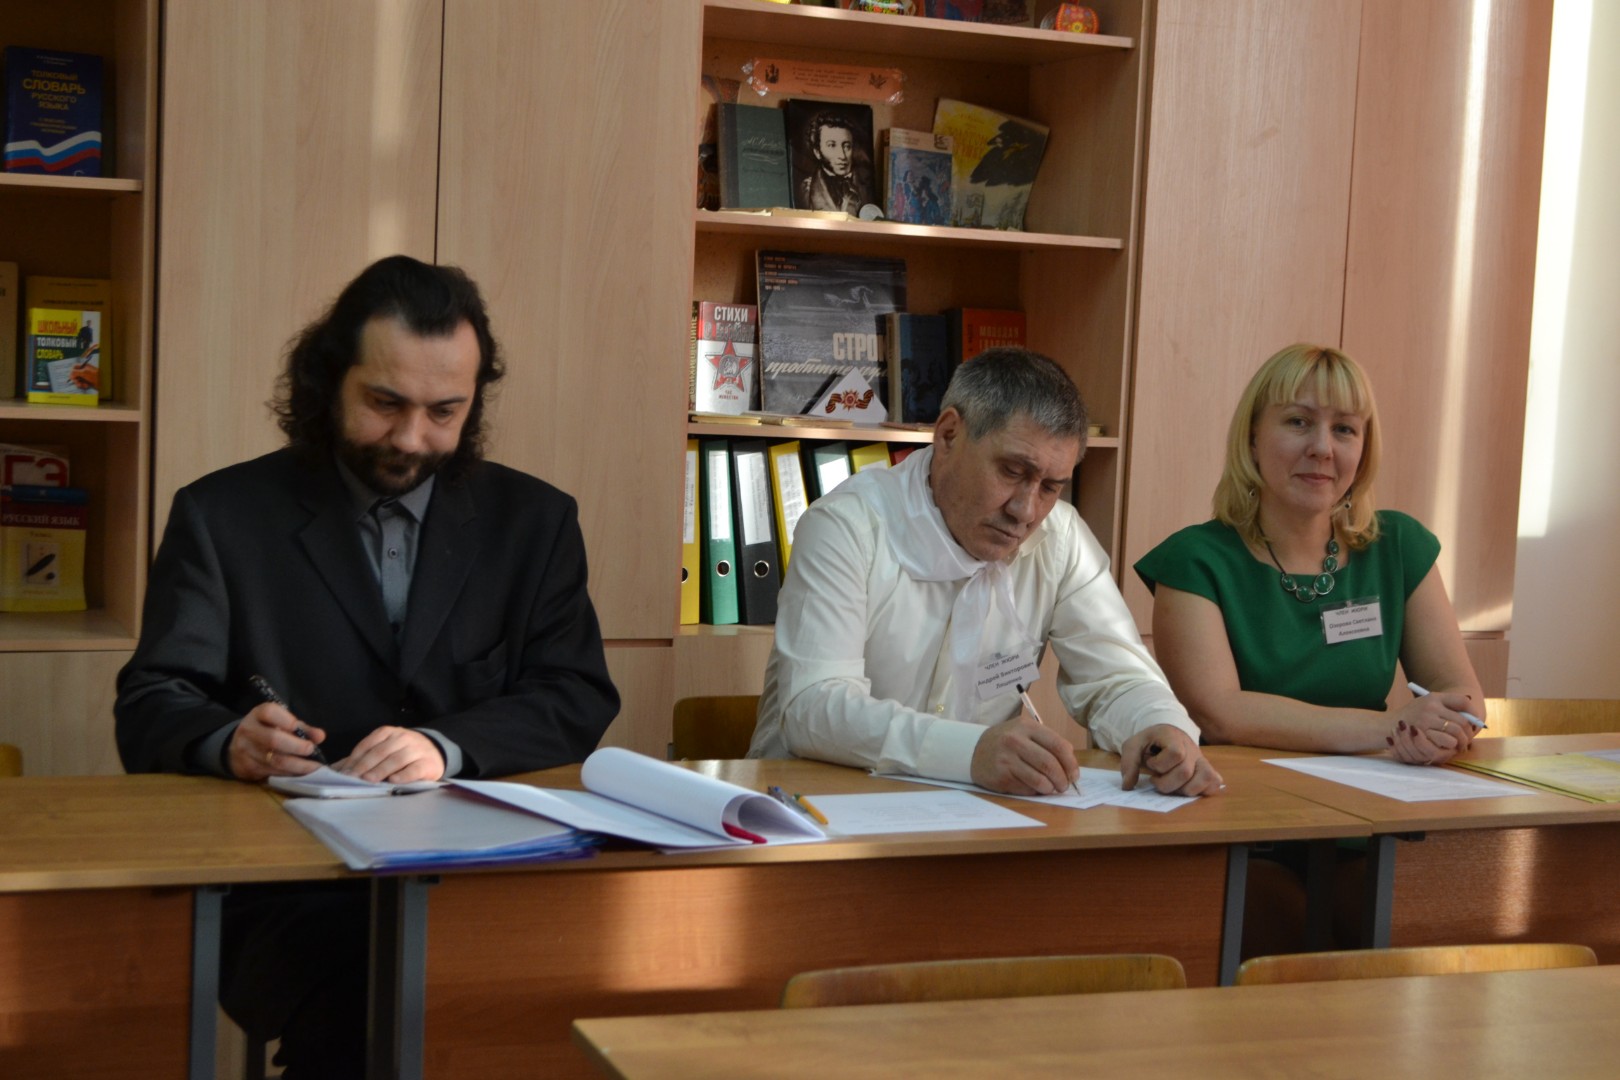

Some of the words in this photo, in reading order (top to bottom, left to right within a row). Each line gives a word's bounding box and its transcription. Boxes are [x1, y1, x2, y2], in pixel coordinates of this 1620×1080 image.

[22, 78, 86, 95] СЛОВАРЬ
[31, 92, 77, 103] РУССКОГО
[39, 101, 69, 110] ЯЗЫКА
[714, 306, 749, 323] СТИХИ
[37, 336, 77, 349] ТОЛКОВЫЙ
[833, 332, 888, 362] СТРОК
[3, 513, 49, 524] РУССКИЙ
[50, 515, 80, 526] ЯЗЫК
[984, 662, 1000, 670] ЧЛЕН
[977, 674, 999, 686] Андрей
[1000, 662, 1034, 677] Викторович
